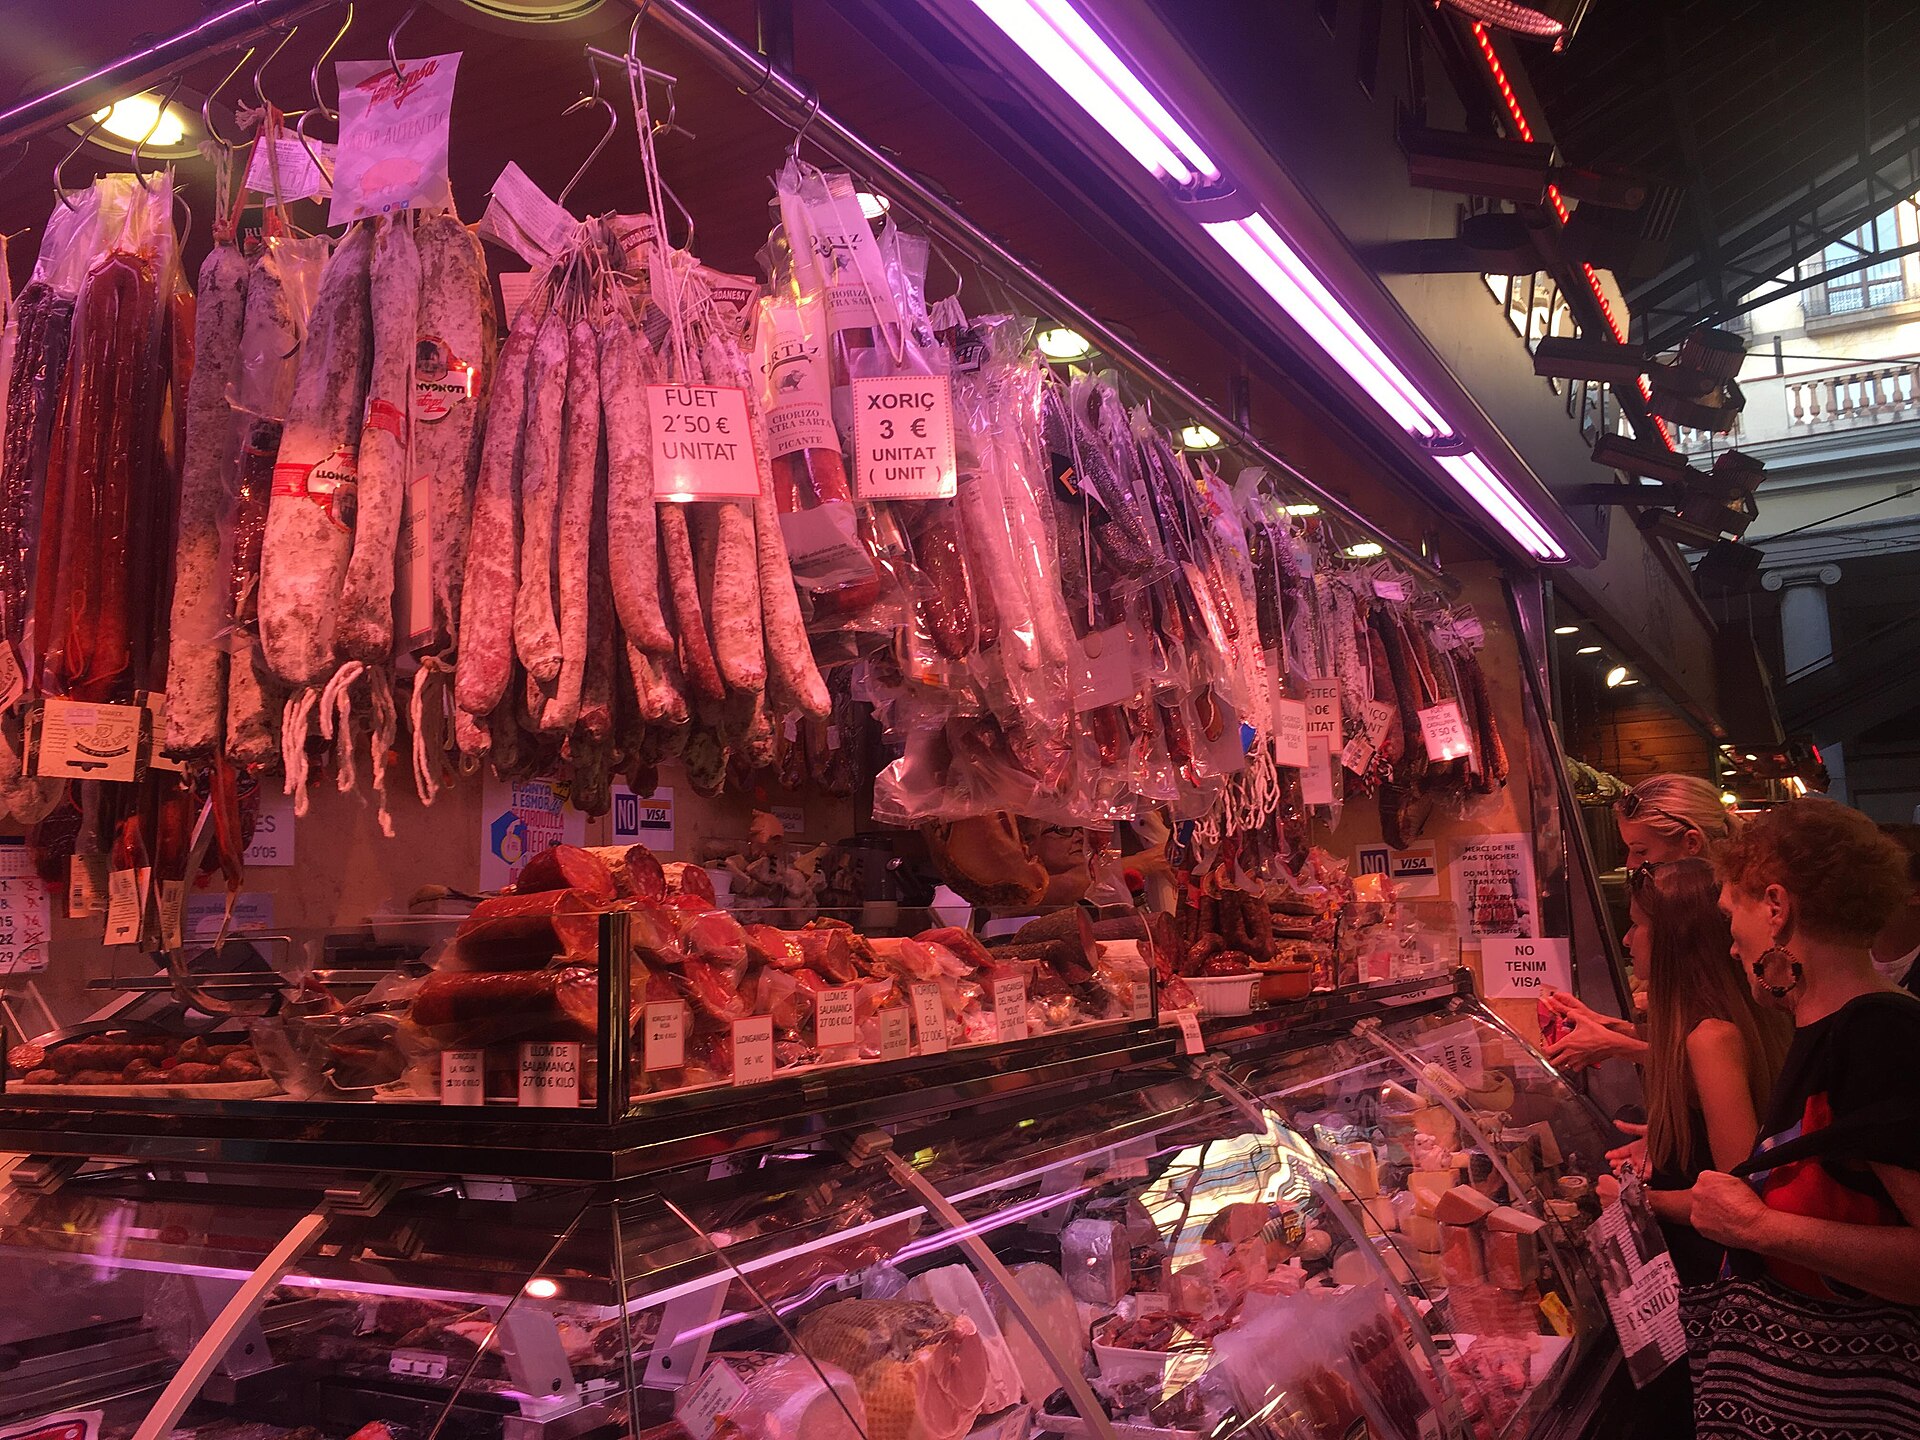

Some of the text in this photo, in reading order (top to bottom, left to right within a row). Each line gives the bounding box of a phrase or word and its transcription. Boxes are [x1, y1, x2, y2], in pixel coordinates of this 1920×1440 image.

[665, 388, 718, 408] FUET
[868, 392, 935, 411] XORIÇ
[772, 409, 820, 425] CHORIZO
[664, 415, 730, 434] 2'50 €
[799, 418, 832, 428] SARTA
[879, 418, 928, 439] 3 €
[778, 436, 823, 451] PICANTE
[662, 442, 738, 462] UNITAT
[872, 447, 936, 461] UNITAT
[885, 467, 925, 481] UNIT
[1451, 725, 1458, 734] €
[618, 800, 666, 830] NO VISA
[1480, 853, 1519, 861] TOUCHER!
[1363, 855, 1426, 874] NO VISA
[1515, 946, 1535, 955] NO
[1505, 961, 1546, 971] TENIM
[1511, 977, 1541, 987] VISA
[840, 991, 848, 1000] DE
[819, 1003, 852, 1014] SALAMANCA
[925, 1000, 934, 1010] DE
[530, 1046, 568, 1057] LLOM DE
[522, 1061, 576, 1072] SALAMANCA
[548, 1077, 554, 1087] €
[556, 1078, 575, 1087] KILO
